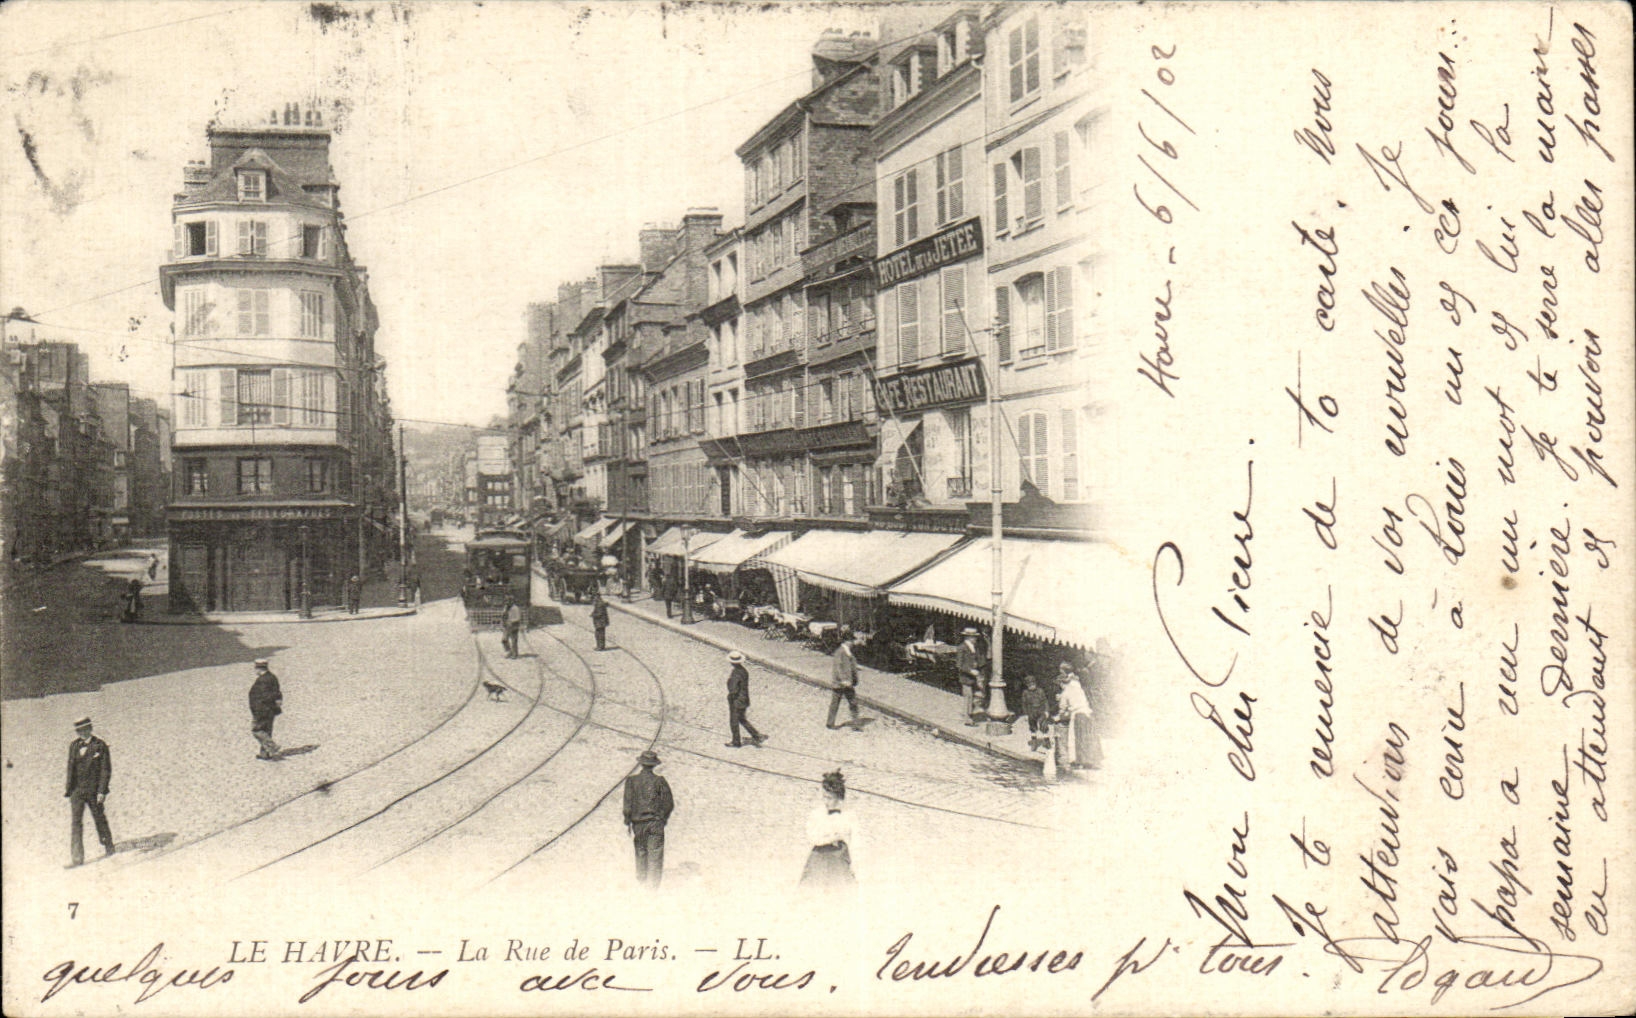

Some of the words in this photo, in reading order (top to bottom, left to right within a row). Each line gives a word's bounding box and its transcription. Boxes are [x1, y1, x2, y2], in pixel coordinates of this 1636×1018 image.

[1532, 6, 1556, 164] main
[1564, 22, 1615, 162] passer
[1469, 102, 1515, 163] la
[1355, 139, 1437, 216] Je
[1522, 190, 1556, 239] la
[1474, 208, 1520, 274] lui
[1560, 180, 1604, 274] aller
[877, 249, 915, 285] HOTEL
[1535, 265, 1559, 340] serre
[1136, 280, 1180, 398] Havre
[1525, 356, 1558, 394] te
[901, 363, 981, 410] RESTAURANT
[1566, 328, 1618, 489] pouvoir
[1405, 456, 1468, 562] Louis
[1444, 350, 1464, 406] un
[1484, 386, 1516, 484] mot
[1522, 427, 1579, 482] Je
[1302, 478, 1338, 550] de
[1375, 506, 1404, 576] vos
[1502, 510, 1520, 574] un
[1368, 599, 1404, 655] de
[1303, 584, 1335, 778] remercie
[1562, 602, 1609, 823] attendant
[1190, 691, 1258, 782] cher
[1500, 766, 1520, 806] a
[1182, 810, 1257, 948] Mon
[1290, 816, 1332, 869] te
[1543, 744, 1576, 945] semaine
[1471, 824, 1542, 952] papa
[1584, 858, 1608, 936] en
[42, 942, 234, 1004] quelques
[518, 966, 654, 993] avec
